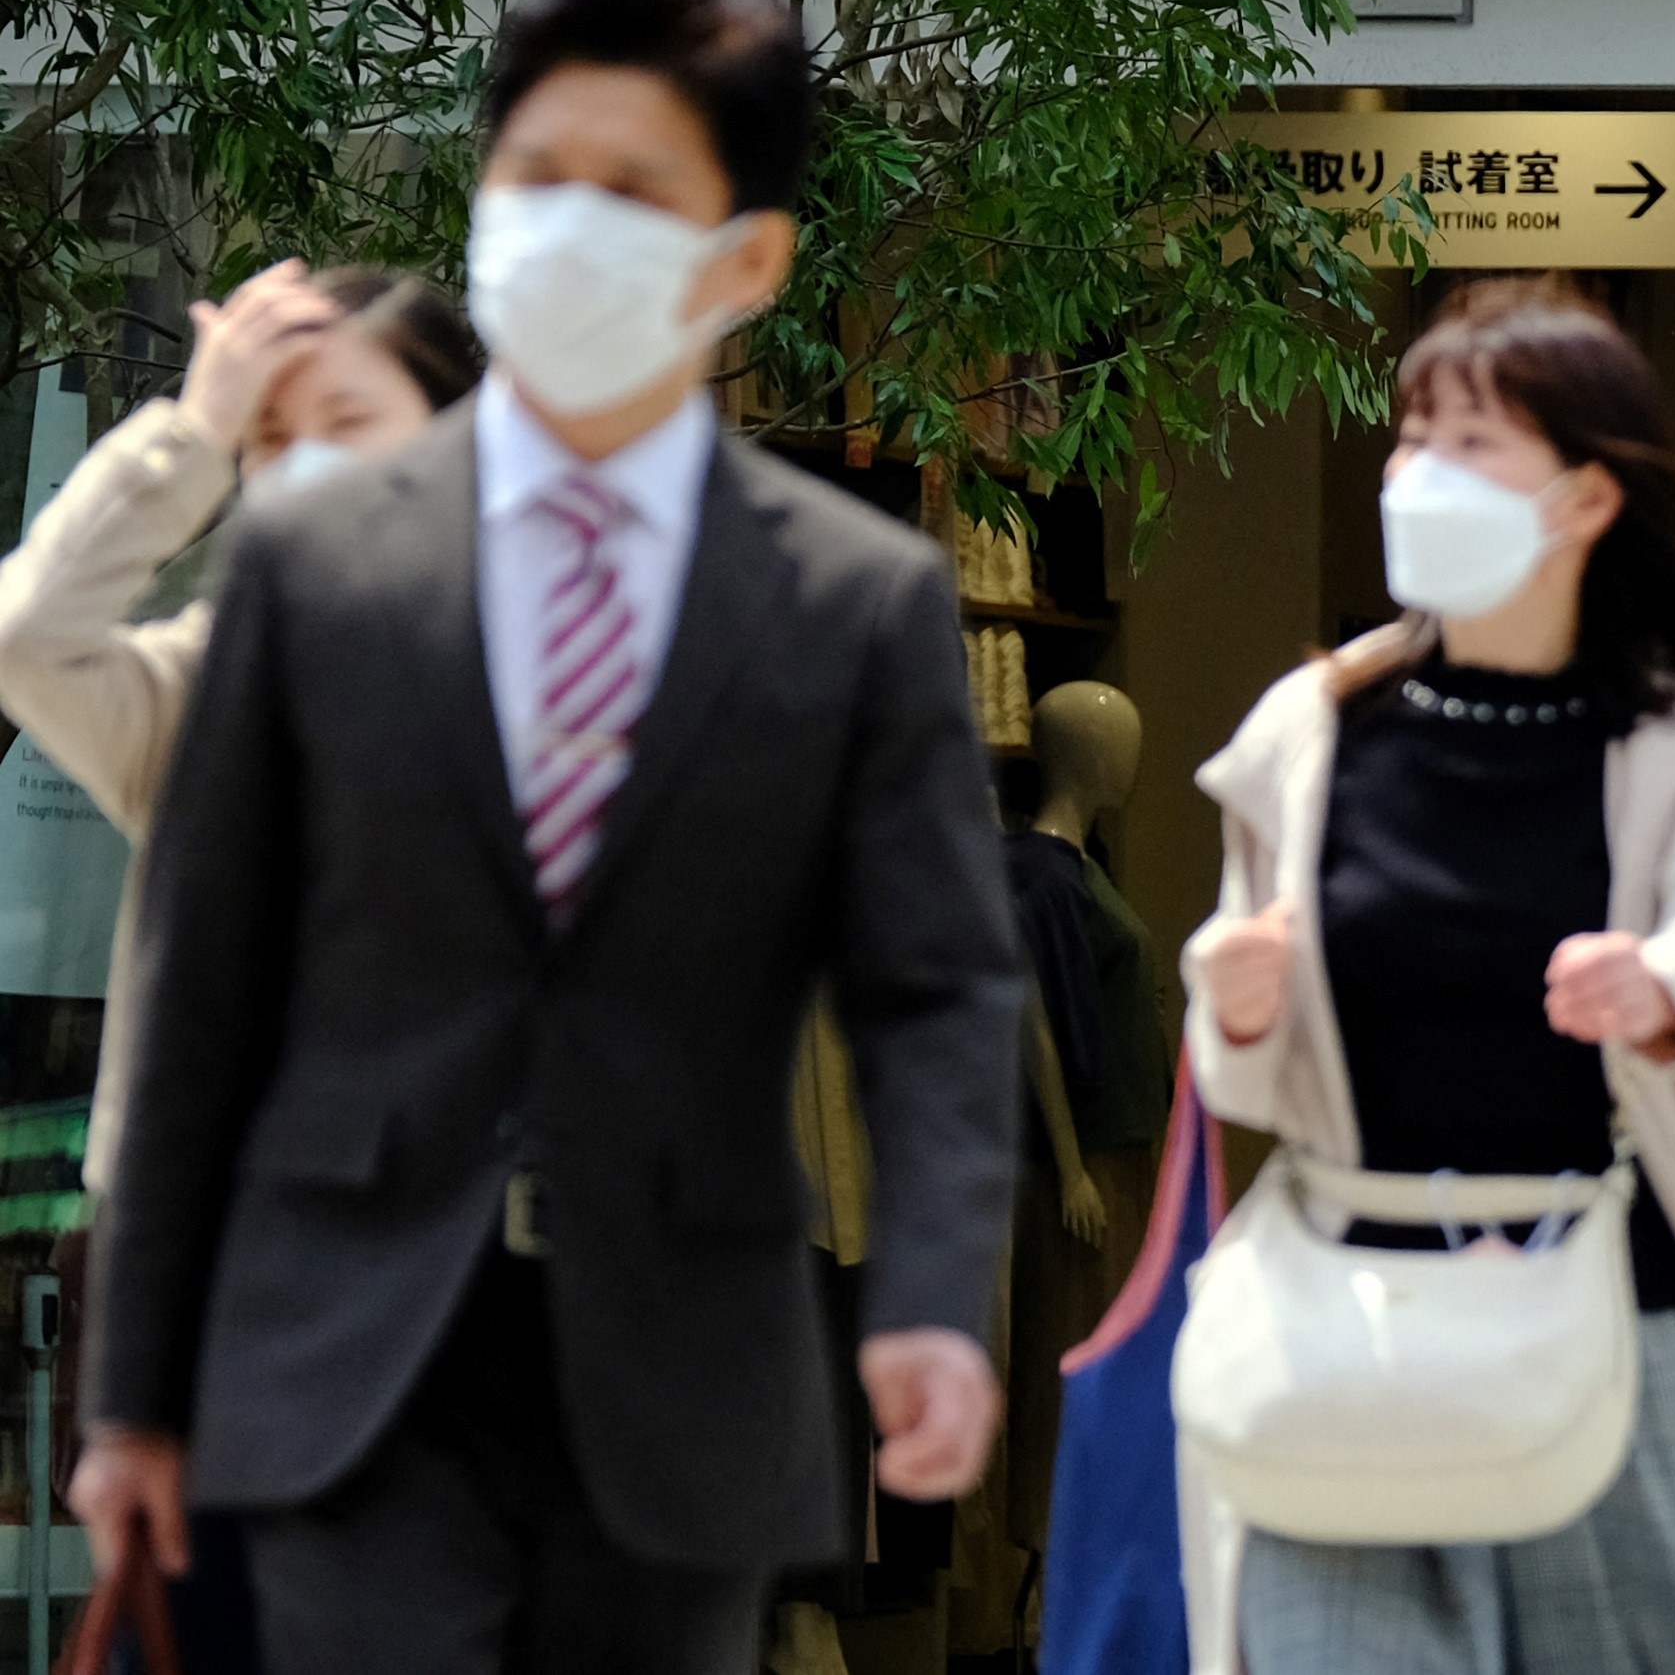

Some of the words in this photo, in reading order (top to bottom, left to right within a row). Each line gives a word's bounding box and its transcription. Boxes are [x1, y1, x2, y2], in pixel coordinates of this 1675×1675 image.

[1419, 149, 1559, 194] 試着室
[1427, 211, 1497, 230] ITTING
[1506, 211, 1560, 230] ROOM
